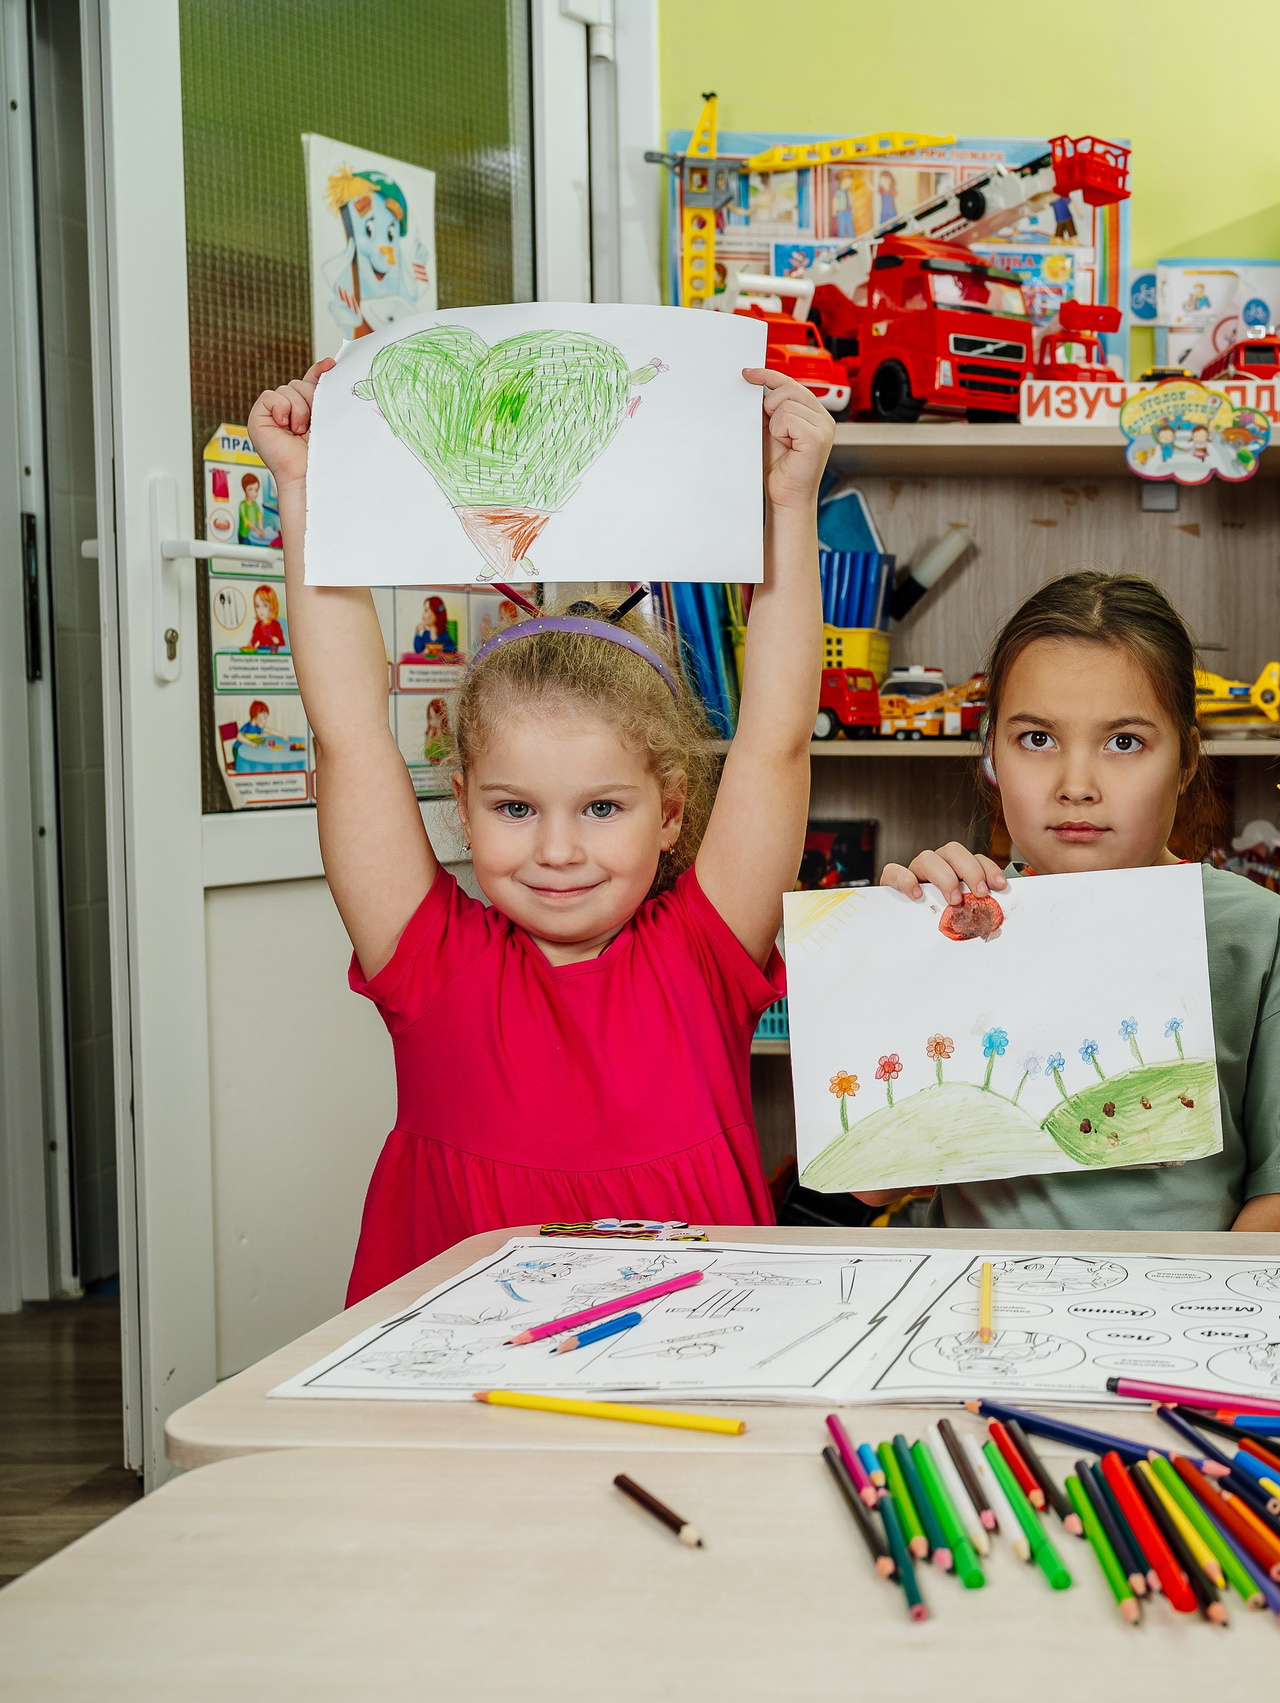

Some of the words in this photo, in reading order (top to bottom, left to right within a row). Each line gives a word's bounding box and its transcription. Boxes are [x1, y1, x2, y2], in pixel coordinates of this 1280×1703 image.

[221, 436, 257, 453] ПРА
[1073, 1306, 1150, 1317] Донни
[1179, 1303, 1256, 1313] Майки
[1106, 1331, 1156, 1341] Лео
[1200, 1329, 1250, 1339] Раф
